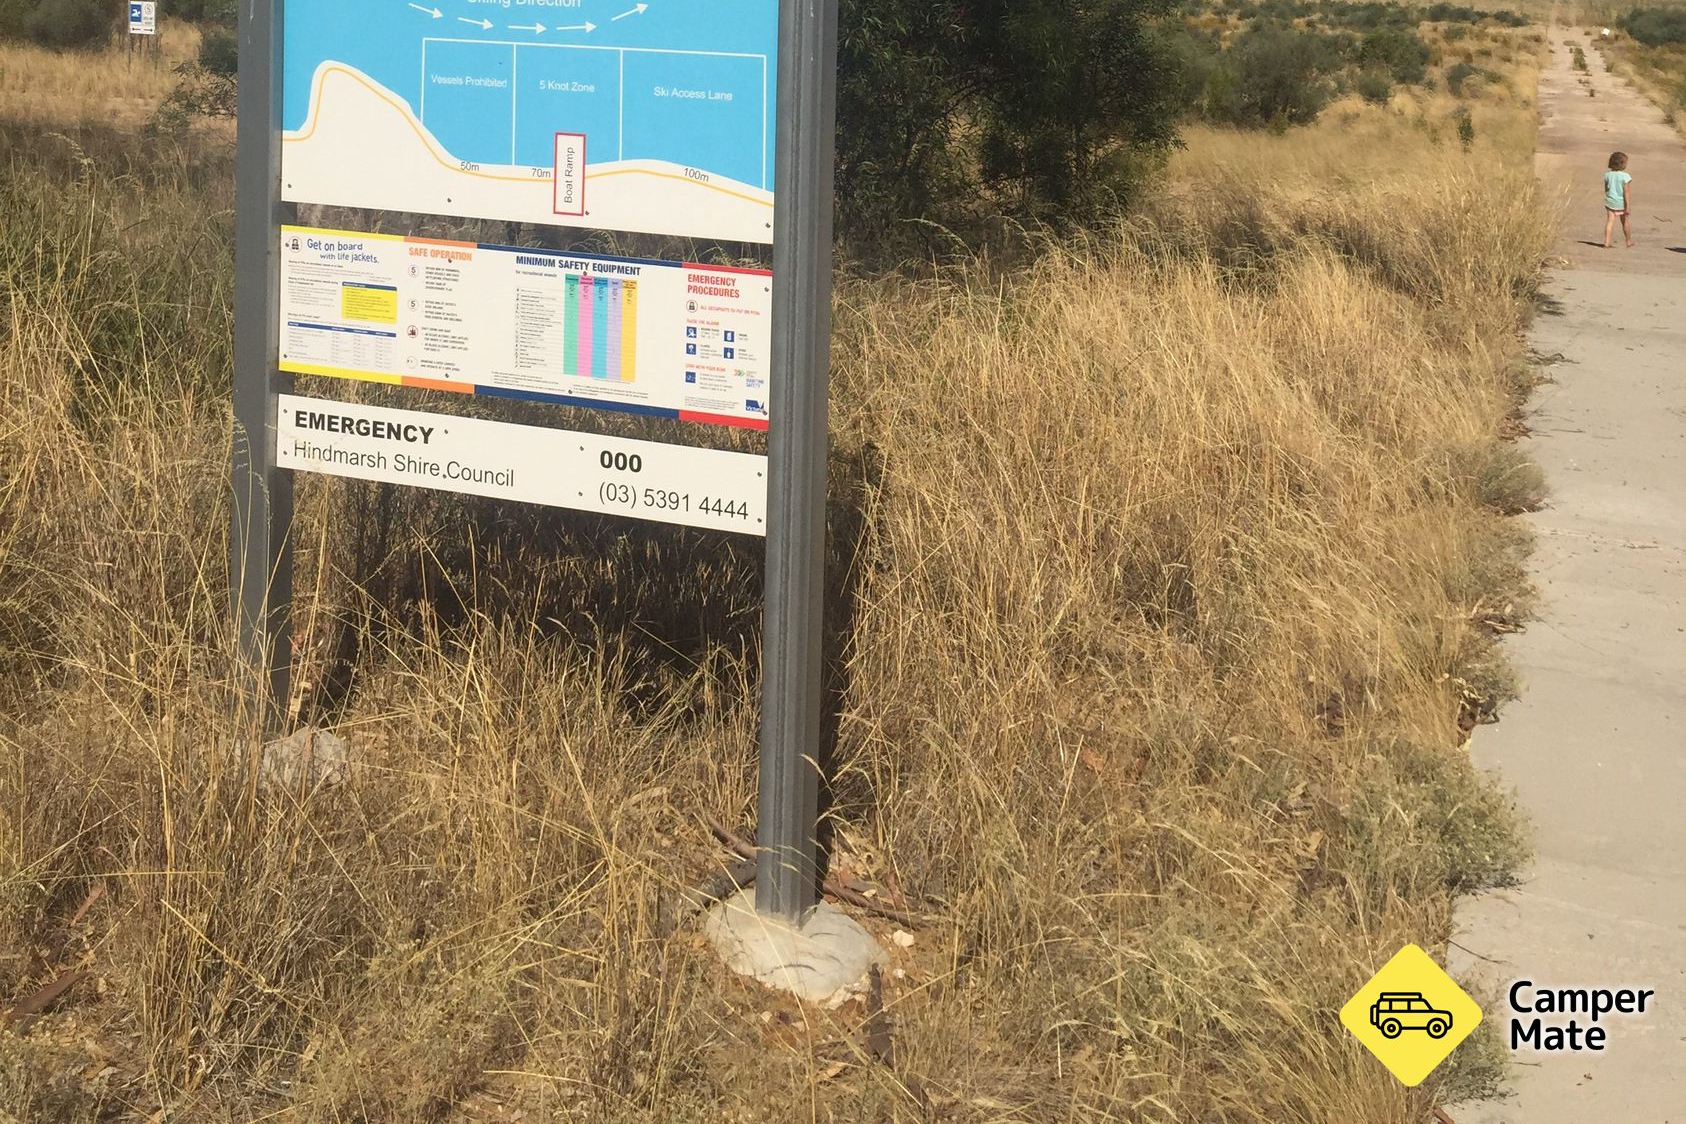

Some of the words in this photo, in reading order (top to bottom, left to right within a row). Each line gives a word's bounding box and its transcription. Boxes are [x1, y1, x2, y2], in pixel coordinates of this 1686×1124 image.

[431, 74, 464, 85] Vessels
[465, 76, 508, 89] Prohibited
[539, 80, 546, 90] 5
[548, 80, 569, 92] Knot
[571, 81, 595, 93] Zone
[653, 86, 669, 97] Ski
[671, 87, 706, 99] Access
[708, 90, 733, 101] Lane
[460, 161, 480, 172] 50m
[564, 147, 575, 177] Ramp
[531, 167, 551, 178] 70m
[683, 167, 710, 183] 100m
[564, 180, 573, 204] Boat
[306, 238, 322, 251] Get
[324, 242, 335, 251] on
[337, 241, 363, 251] board
[319, 252, 336, 260] with
[337, 252, 350, 261] life
[408, 246, 429, 257] SAFE
[430, 248, 473, 261] OPERATION
[516, 255, 556, 268] MINIMUM
[558, 259, 590, 271] SAFETY
[592, 262, 641, 276] EQUIPMENT
[687, 273, 737, 287] EMERGENCY
[687, 284, 740, 298] PROCEDURES
[294, 410, 434, 444] EMERGENCY
[294, 439, 387, 470] Hindmarsh
[393, 453, 441, 477] Shire
[446, 461, 515, 487] Council
[599, 449, 643, 474] 000
[598, 480, 637, 509] (03)
[642, 488, 692, 513] 5391
[698, 496, 749, 521] 4444
